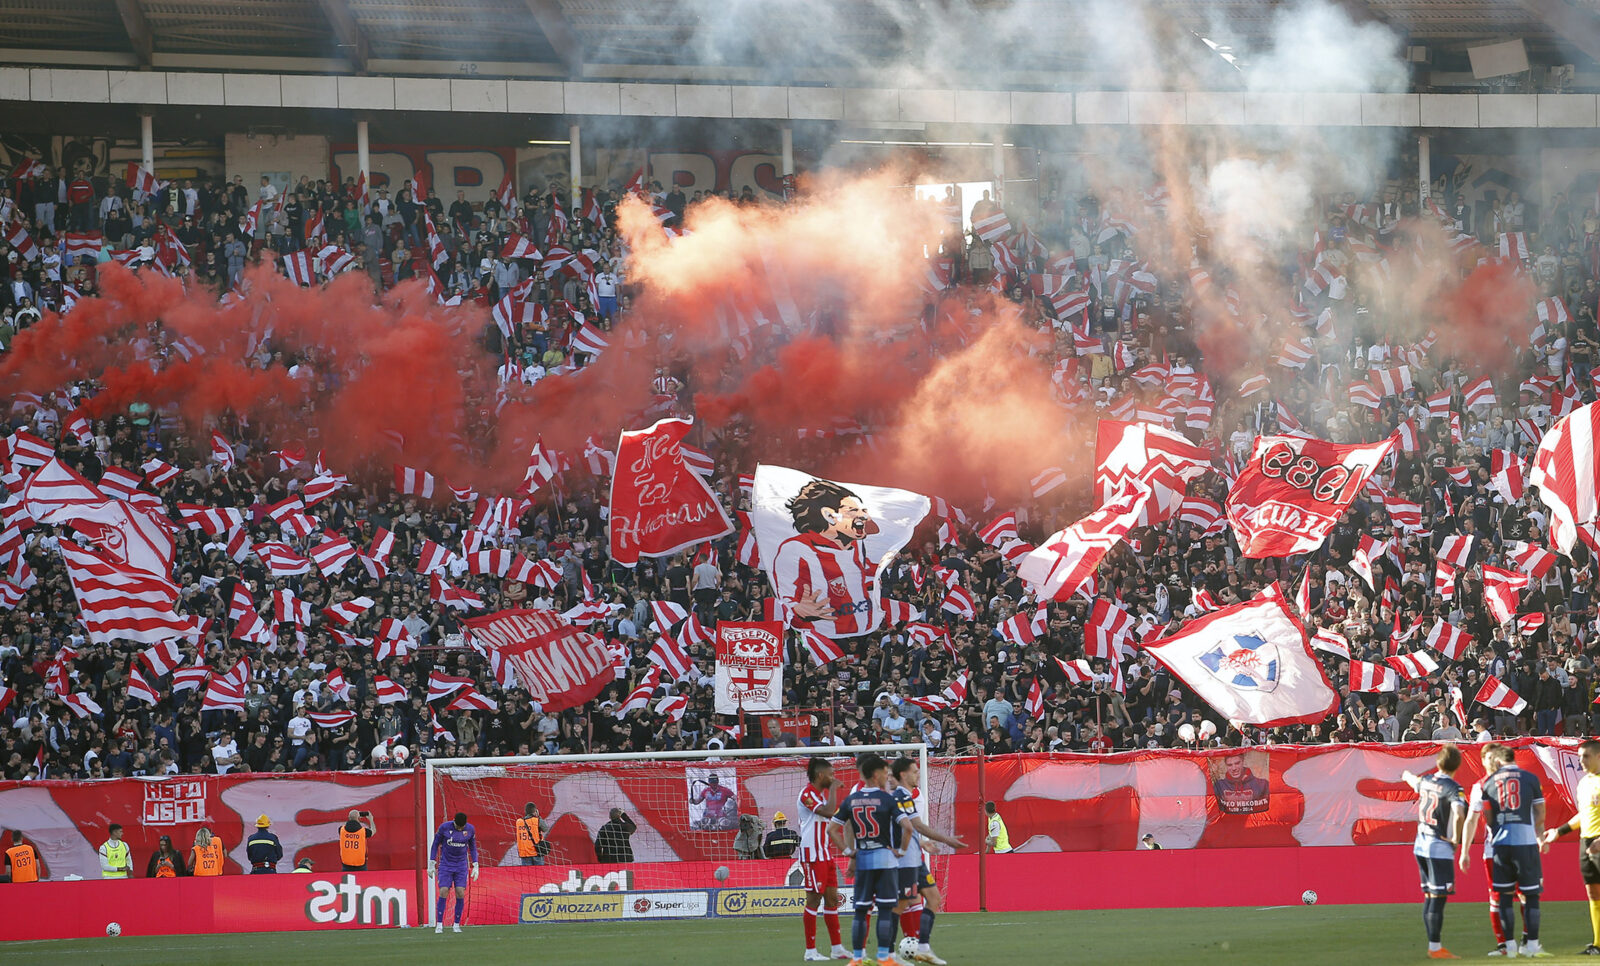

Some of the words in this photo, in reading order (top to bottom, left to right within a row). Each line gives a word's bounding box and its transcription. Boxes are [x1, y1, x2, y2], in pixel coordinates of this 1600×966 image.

[727, 630, 776, 645] СЕВЕРНА
[719, 654, 781, 667] МИРИЈЕВО
[1494, 778, 1521, 812] 18
[852, 805, 880, 839] 55
[344, 840, 360, 850] 018
[16, 857, 31, 868] 037
[556, 902, 619, 914] MOZZART
[654, 901, 700, 911] SuperLiga
